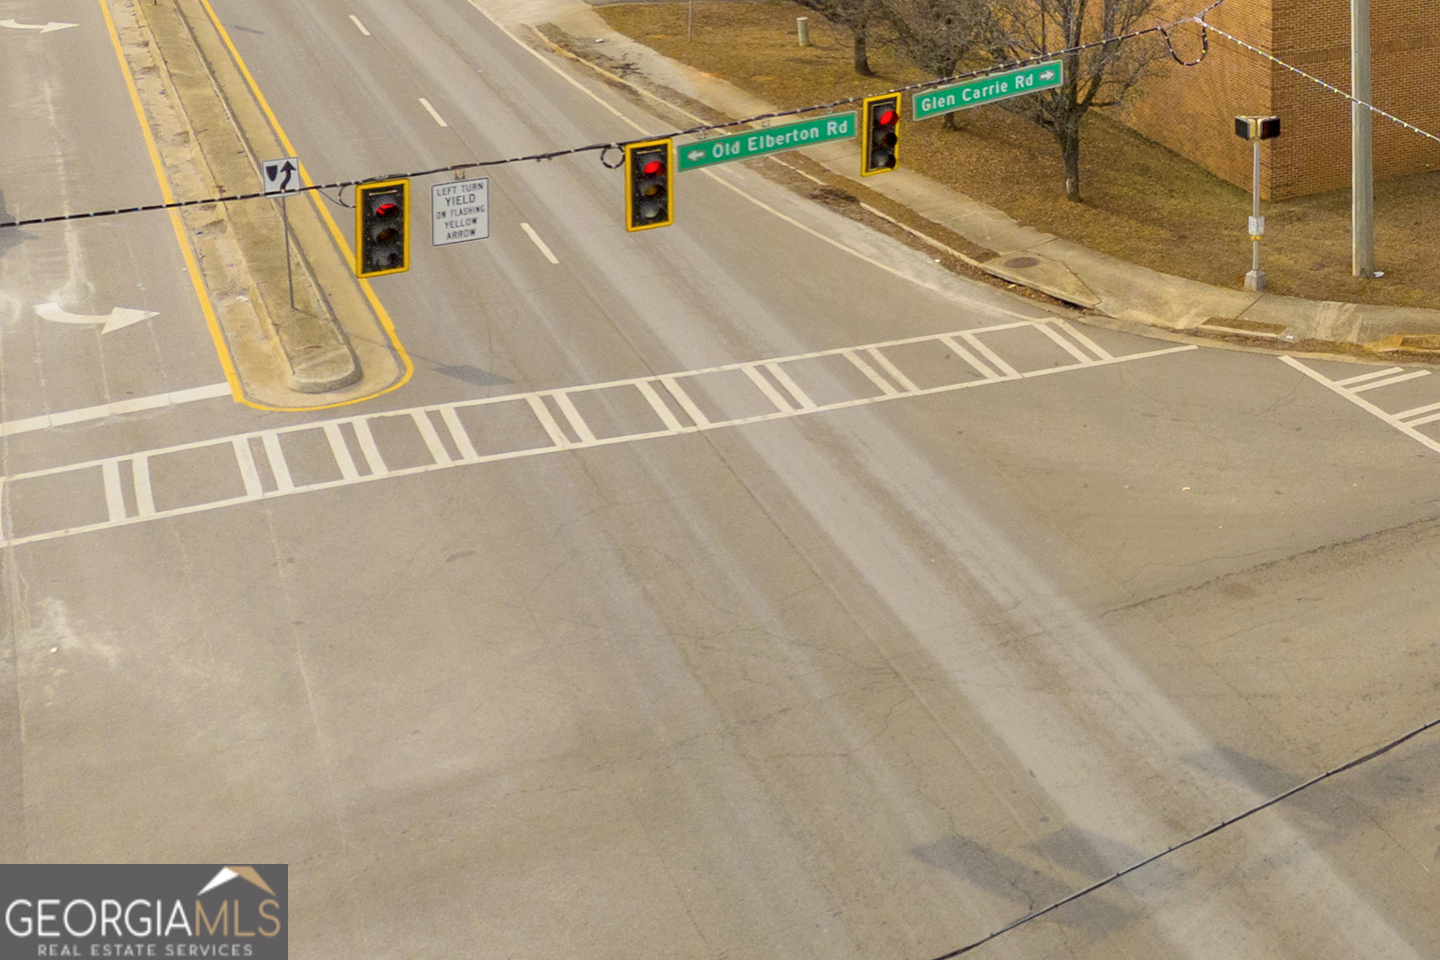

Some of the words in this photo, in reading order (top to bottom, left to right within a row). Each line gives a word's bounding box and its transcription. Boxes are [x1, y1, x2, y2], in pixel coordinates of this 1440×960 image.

[921, 93, 955, 112] Glen
[961, 81, 1008, 102] Carrie
[1015, 74, 1033, 89] Rd
[712, 141, 740, 159] Old
[748, 126, 819, 151] Elberton
[826, 120, 848, 136] Rd
[436, 186, 457, 197] LEFT
[461, 182, 483, 193] TURN
[445, 193, 476, 207] YIELD
[436, 211, 446, 220] ON
[450, 204, 485, 217] FLASHING
[444, 217, 477, 229] YELLOW
[446, 229, 476, 240] ARROW
